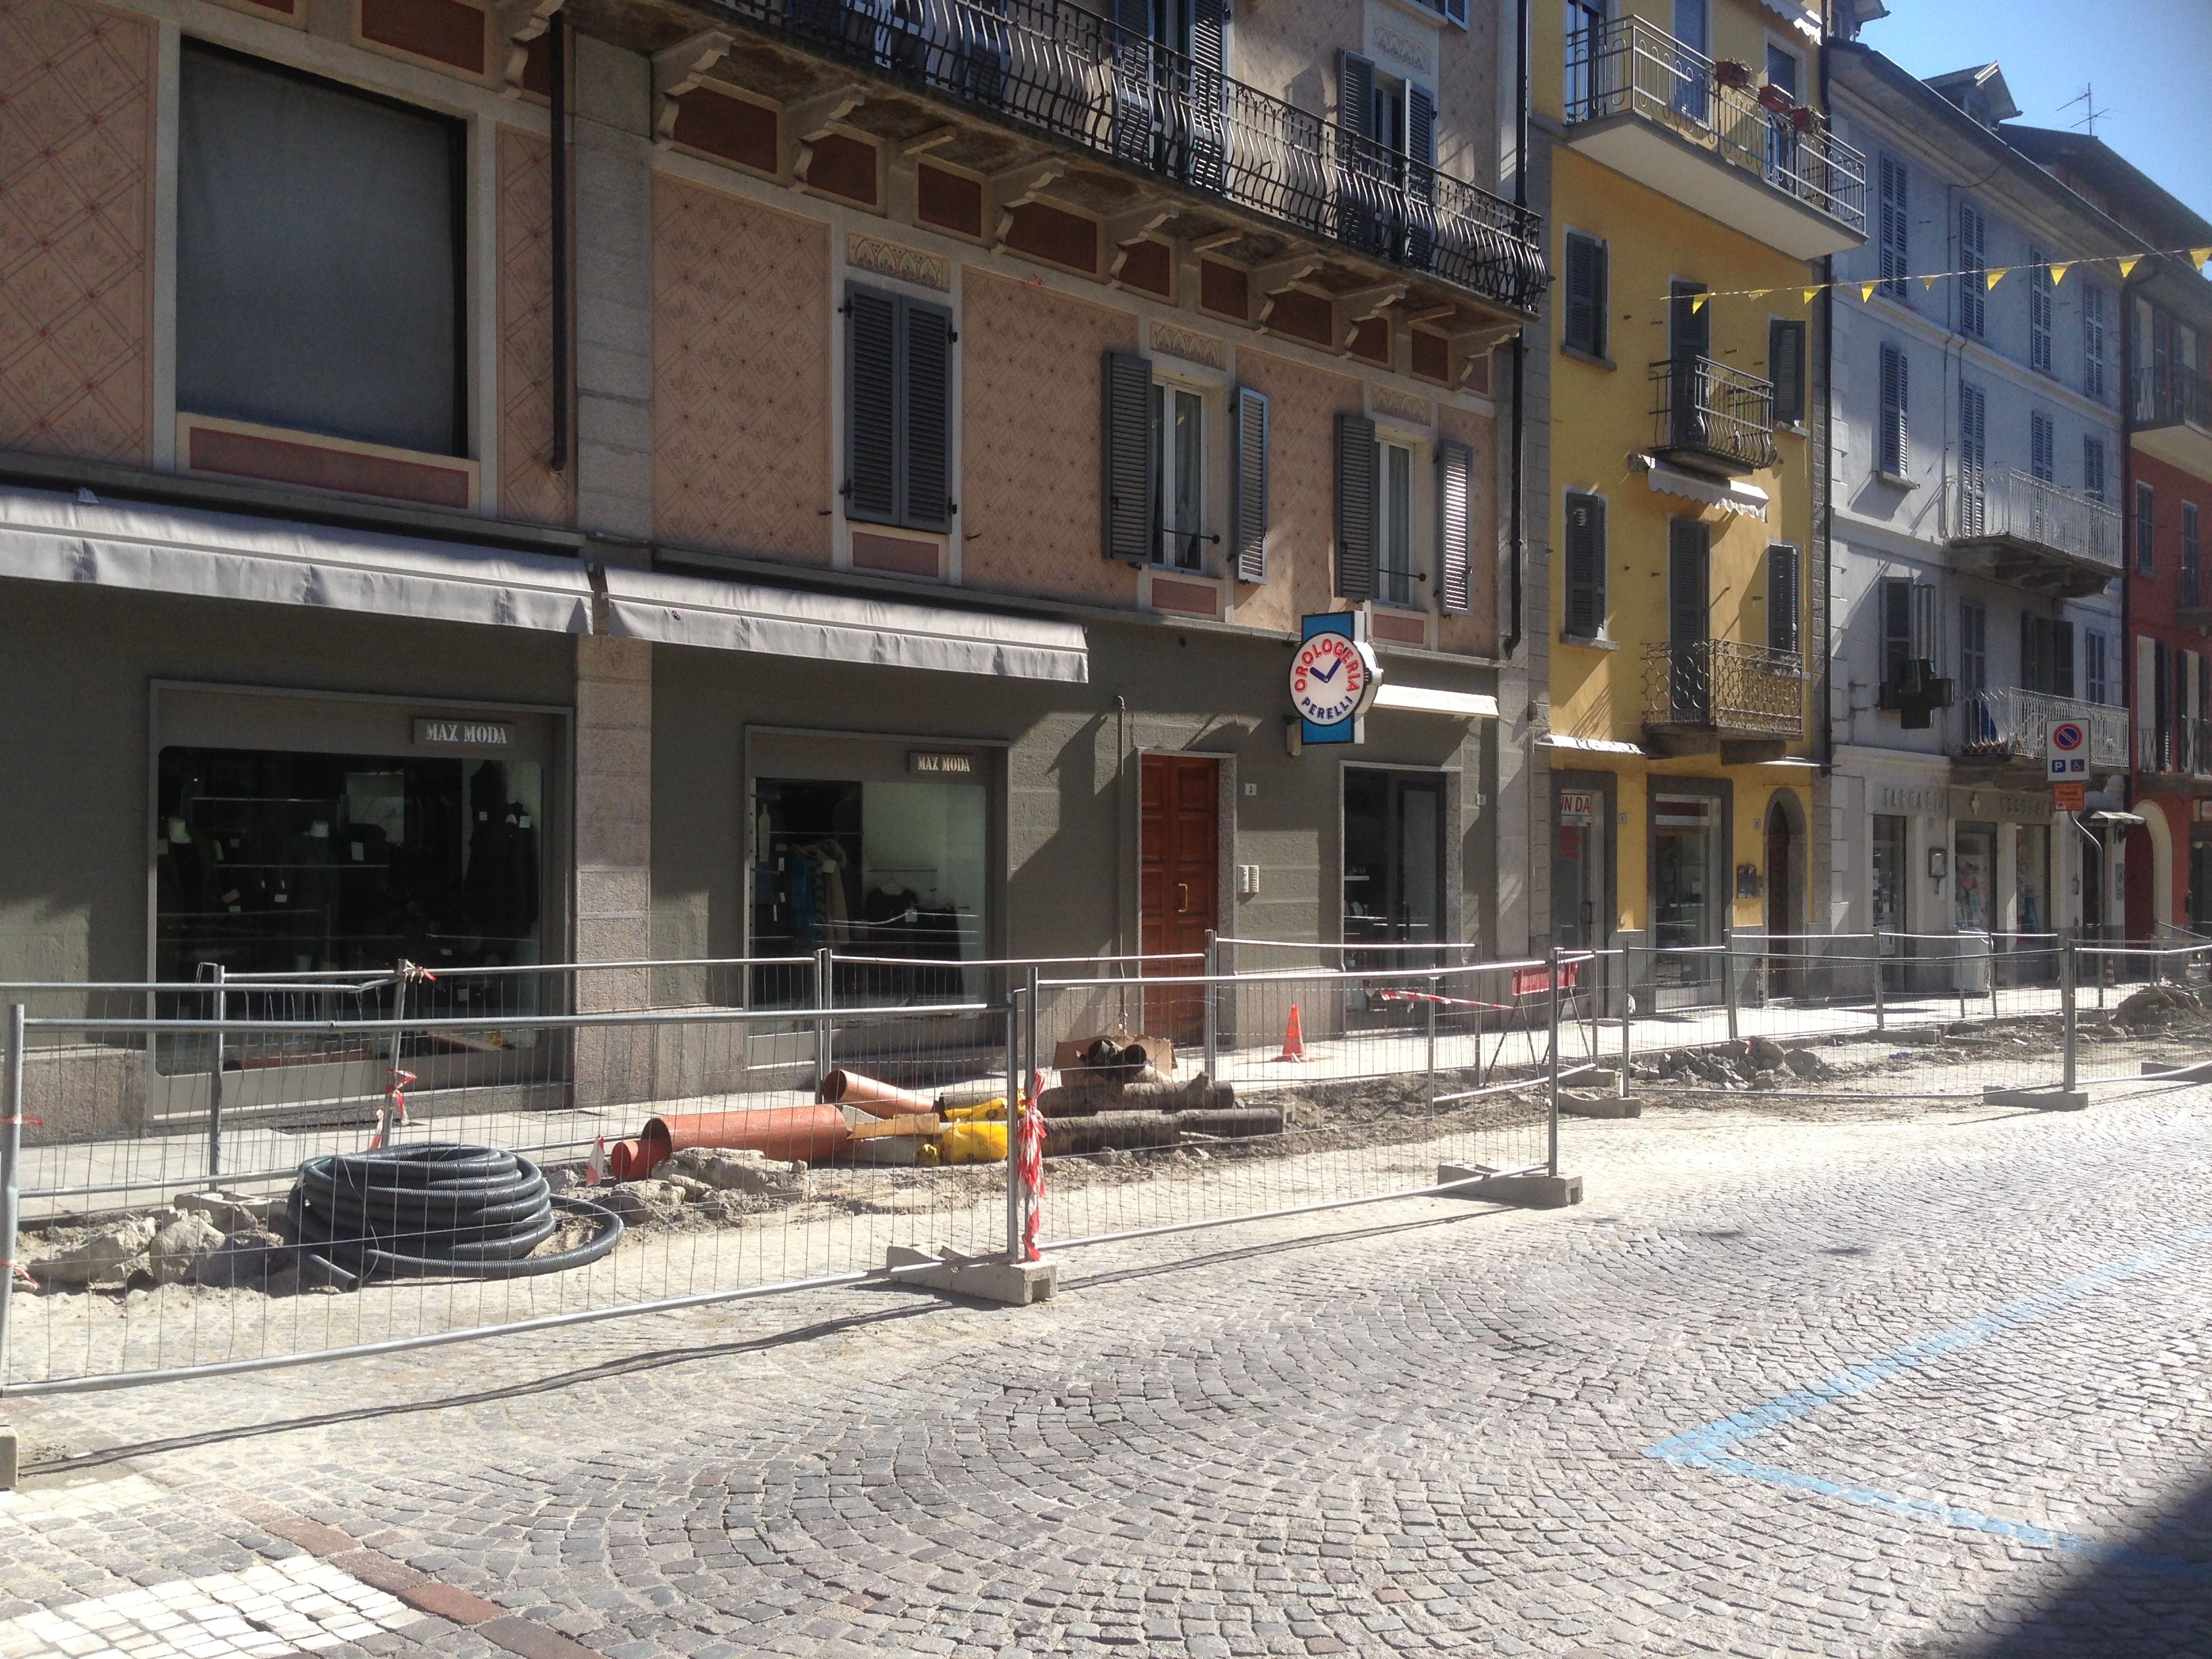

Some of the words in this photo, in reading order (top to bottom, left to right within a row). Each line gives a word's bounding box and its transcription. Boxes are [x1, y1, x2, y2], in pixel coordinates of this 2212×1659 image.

[1294, 638, 1361, 693] OROLOGERIA
[1300, 695, 1353, 720] PERELLI
[426, 723, 459, 742] MAX
[464, 725, 507, 744] MODA
[917, 756, 939, 771] MAX
[941, 756, 970, 773] MODA
[1575, 796, 1590, 813] DA
